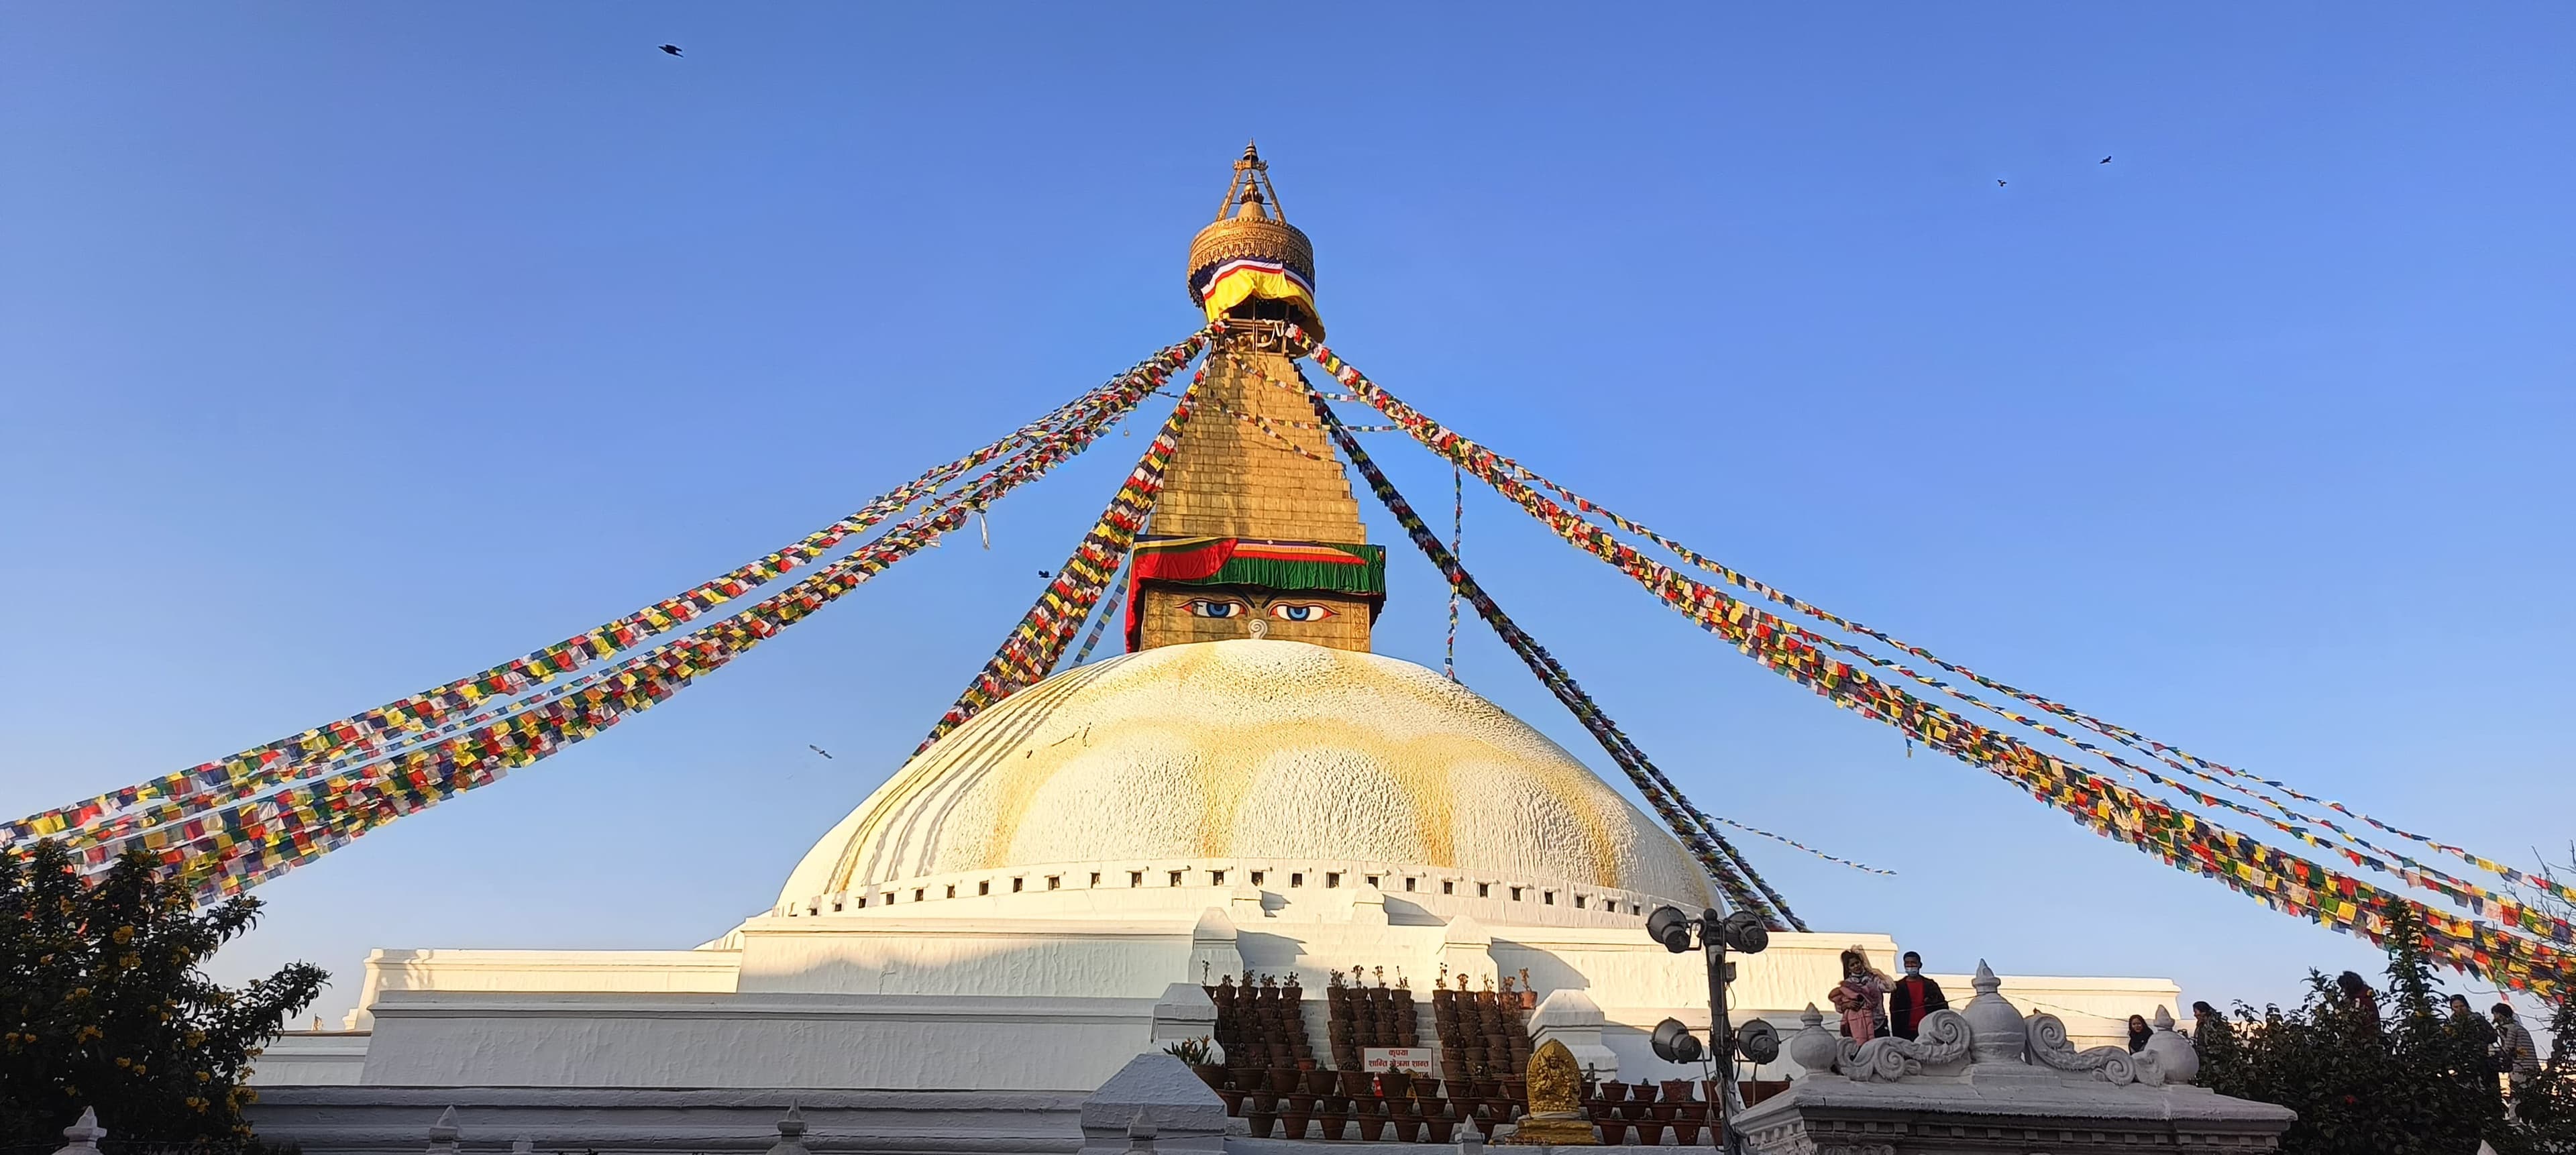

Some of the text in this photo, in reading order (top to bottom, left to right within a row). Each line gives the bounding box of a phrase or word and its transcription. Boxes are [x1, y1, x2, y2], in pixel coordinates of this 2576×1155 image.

[1389, 1049, 1408, 1058] कृपया
[1368, 1058, 1388, 1067] शान्ति
[1412, 1060, 1429, 1068] शान्त
